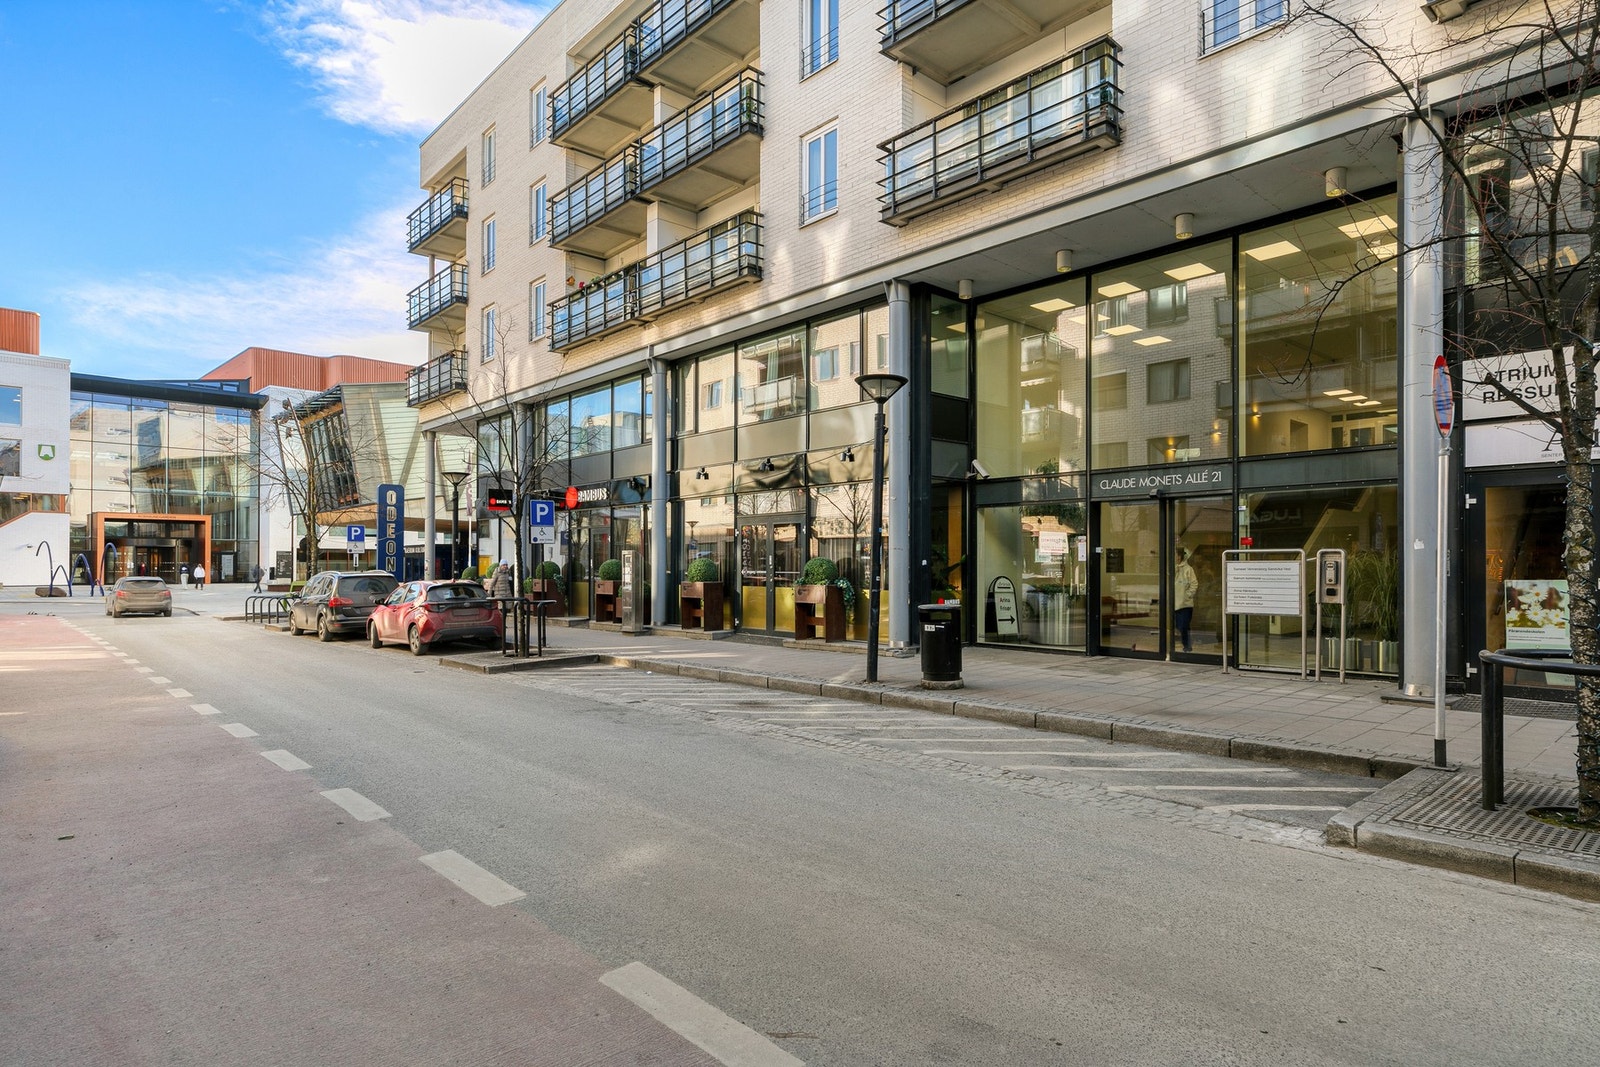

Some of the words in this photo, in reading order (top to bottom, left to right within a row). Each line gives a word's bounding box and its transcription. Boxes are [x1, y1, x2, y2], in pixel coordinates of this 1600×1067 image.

[1483, 382, 1578, 404] RSSUS
[1100, 477, 1136, 490] CLAUDE
[1139, 474, 1182, 488] MONETS
[1185, 469, 1208, 484] ALLÉ
[1211, 471, 1222, 482] 21
[577, 487, 608, 502] BAMBUS
[536, 503, 549, 523] P
[351, 527, 361, 540] P
[385, 490, 397, 572] ODEON
